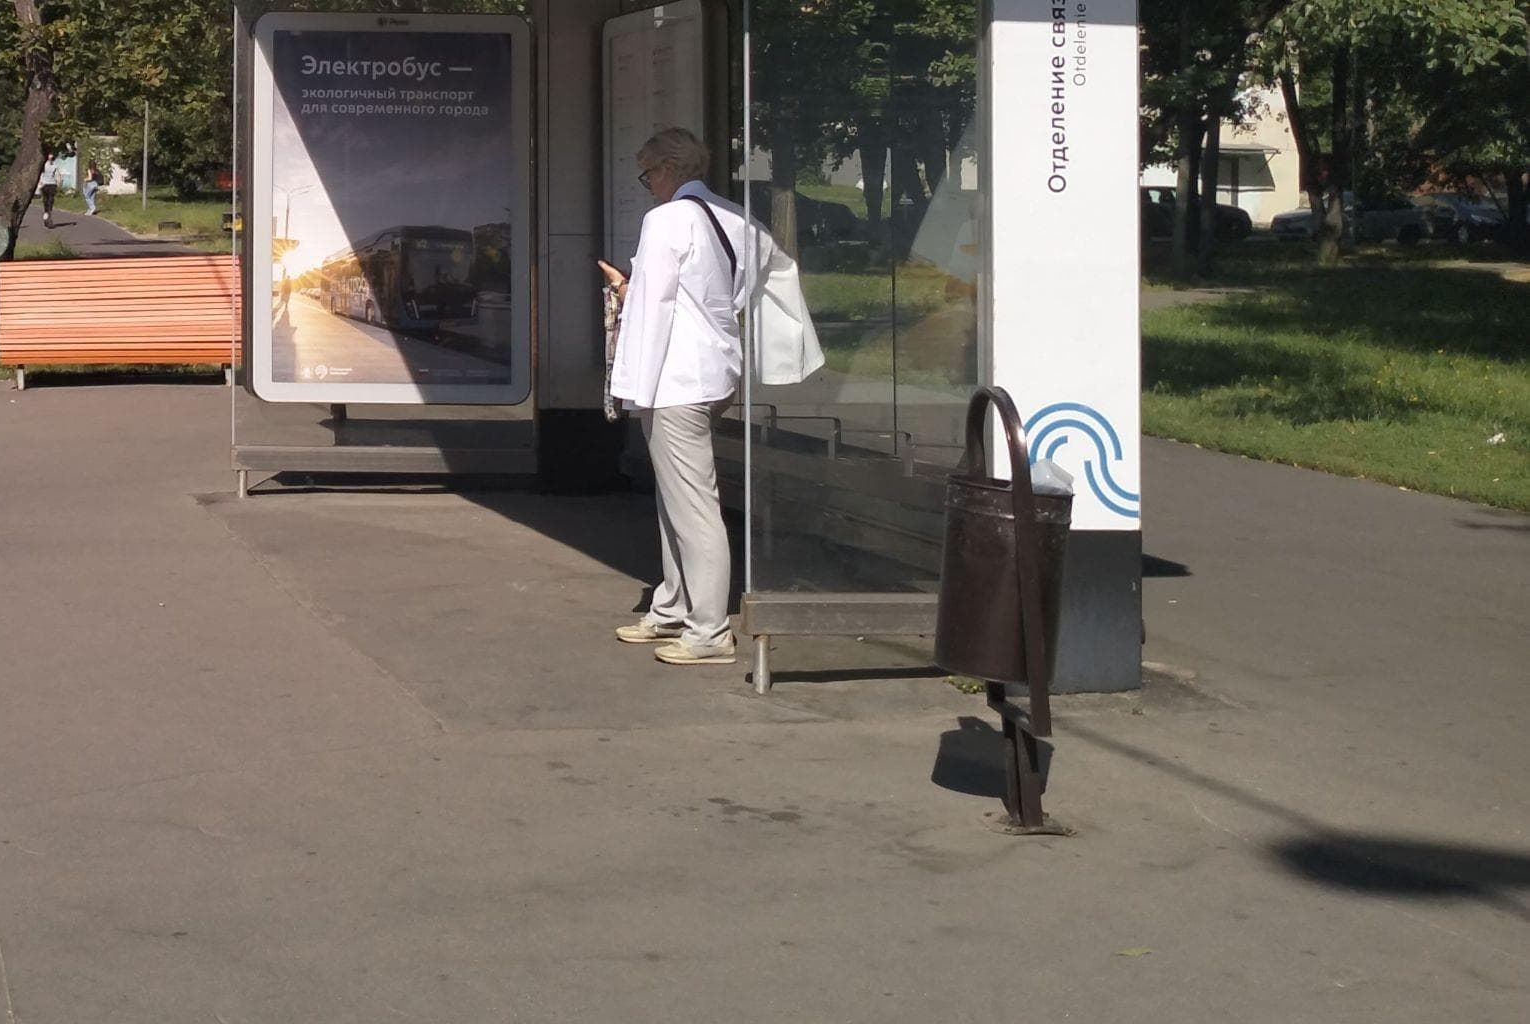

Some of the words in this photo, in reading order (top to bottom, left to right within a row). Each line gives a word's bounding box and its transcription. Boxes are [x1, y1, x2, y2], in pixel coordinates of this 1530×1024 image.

[1073, 4, 1087, 86] Otdelenie
[301, 55, 441, 81] Электробус
[301, 87, 396, 100] экологичный
[400, 89, 474, 103] транспорт
[301, 103, 328, 115] для
[331, 104, 435, 117] современного
[439, 106, 489, 117] города
[1048, 56, 1069, 193] Отделение
